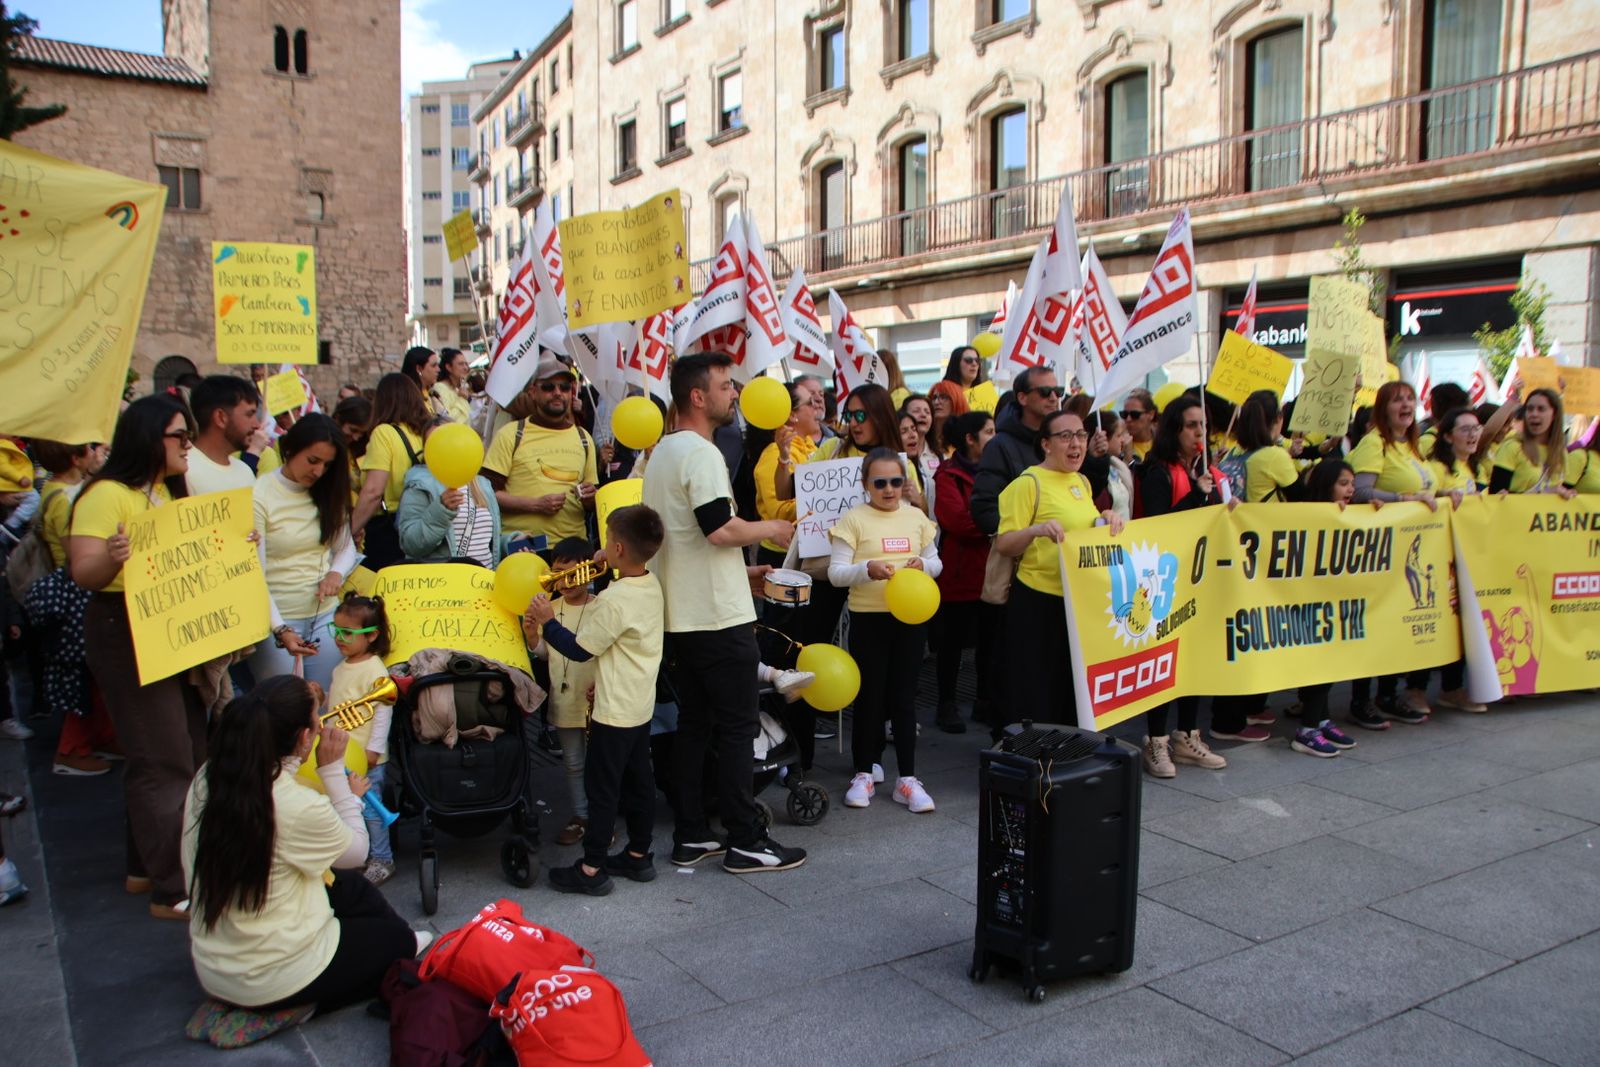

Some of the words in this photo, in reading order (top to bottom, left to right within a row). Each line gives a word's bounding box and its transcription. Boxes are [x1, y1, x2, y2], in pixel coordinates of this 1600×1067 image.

[35, 218, 83, 261] SE
[593, 265, 604, 280] la
[615, 268, 642, 279] casa
[646, 257, 655, 272] de
[657, 252, 673, 267] los
[583, 289, 594, 312] 7
[601, 282, 668, 312] ENANITOS
[177, 497, 231, 535] EDUCAR
[154, 536, 218, 577] CORAZONES
[1078, 543, 1124, 569] MALTRATO
[1267, 529, 1308, 579] EN
[1313, 526, 1394, 578] LUCHA
[134, 564, 219, 620] NECESITAMOS
[1555, 576, 1600, 595] CCOO
[1156, 598, 1196, 641] SOLUCIONES
[1338, 598, 1367, 641] YA!
[1412, 624, 1423, 636] EN
[1425, 621, 1437, 634] PIE
[1094, 651, 1173, 704] CCOO
